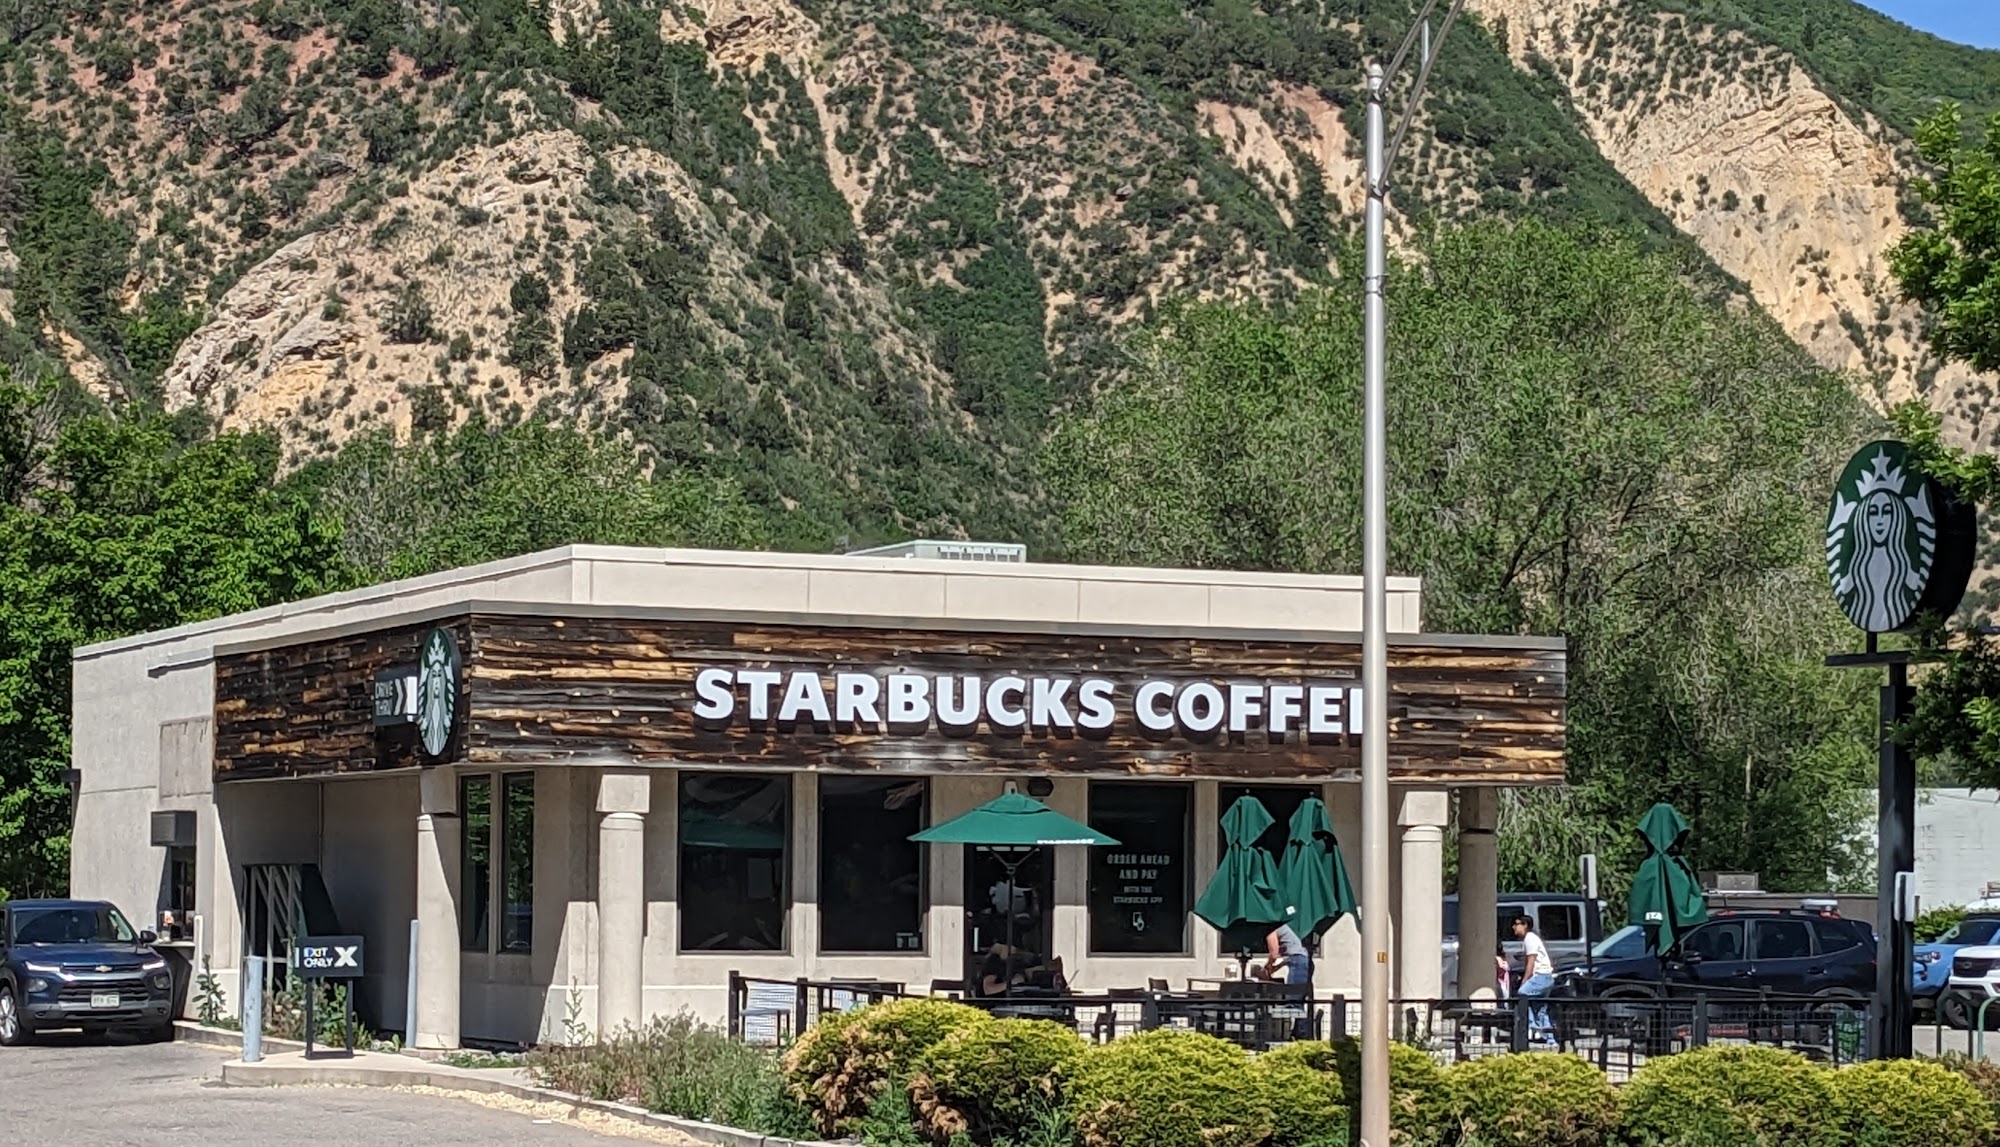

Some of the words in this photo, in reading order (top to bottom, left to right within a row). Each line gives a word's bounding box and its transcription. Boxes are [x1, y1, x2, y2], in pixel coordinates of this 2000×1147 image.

[375, 680, 393, 699] DRIVE
[694, 668, 1116, 729] STARBUCKS
[1107, 854, 1137, 864] ORDER
[1140, 854, 1170, 865] AHEAD
[1119, 869, 1138, 879] AND
[1141, 869, 1157, 879] PAY
[303, 946, 328, 957] EXIT
[303, 957, 333, 968] ONLY
